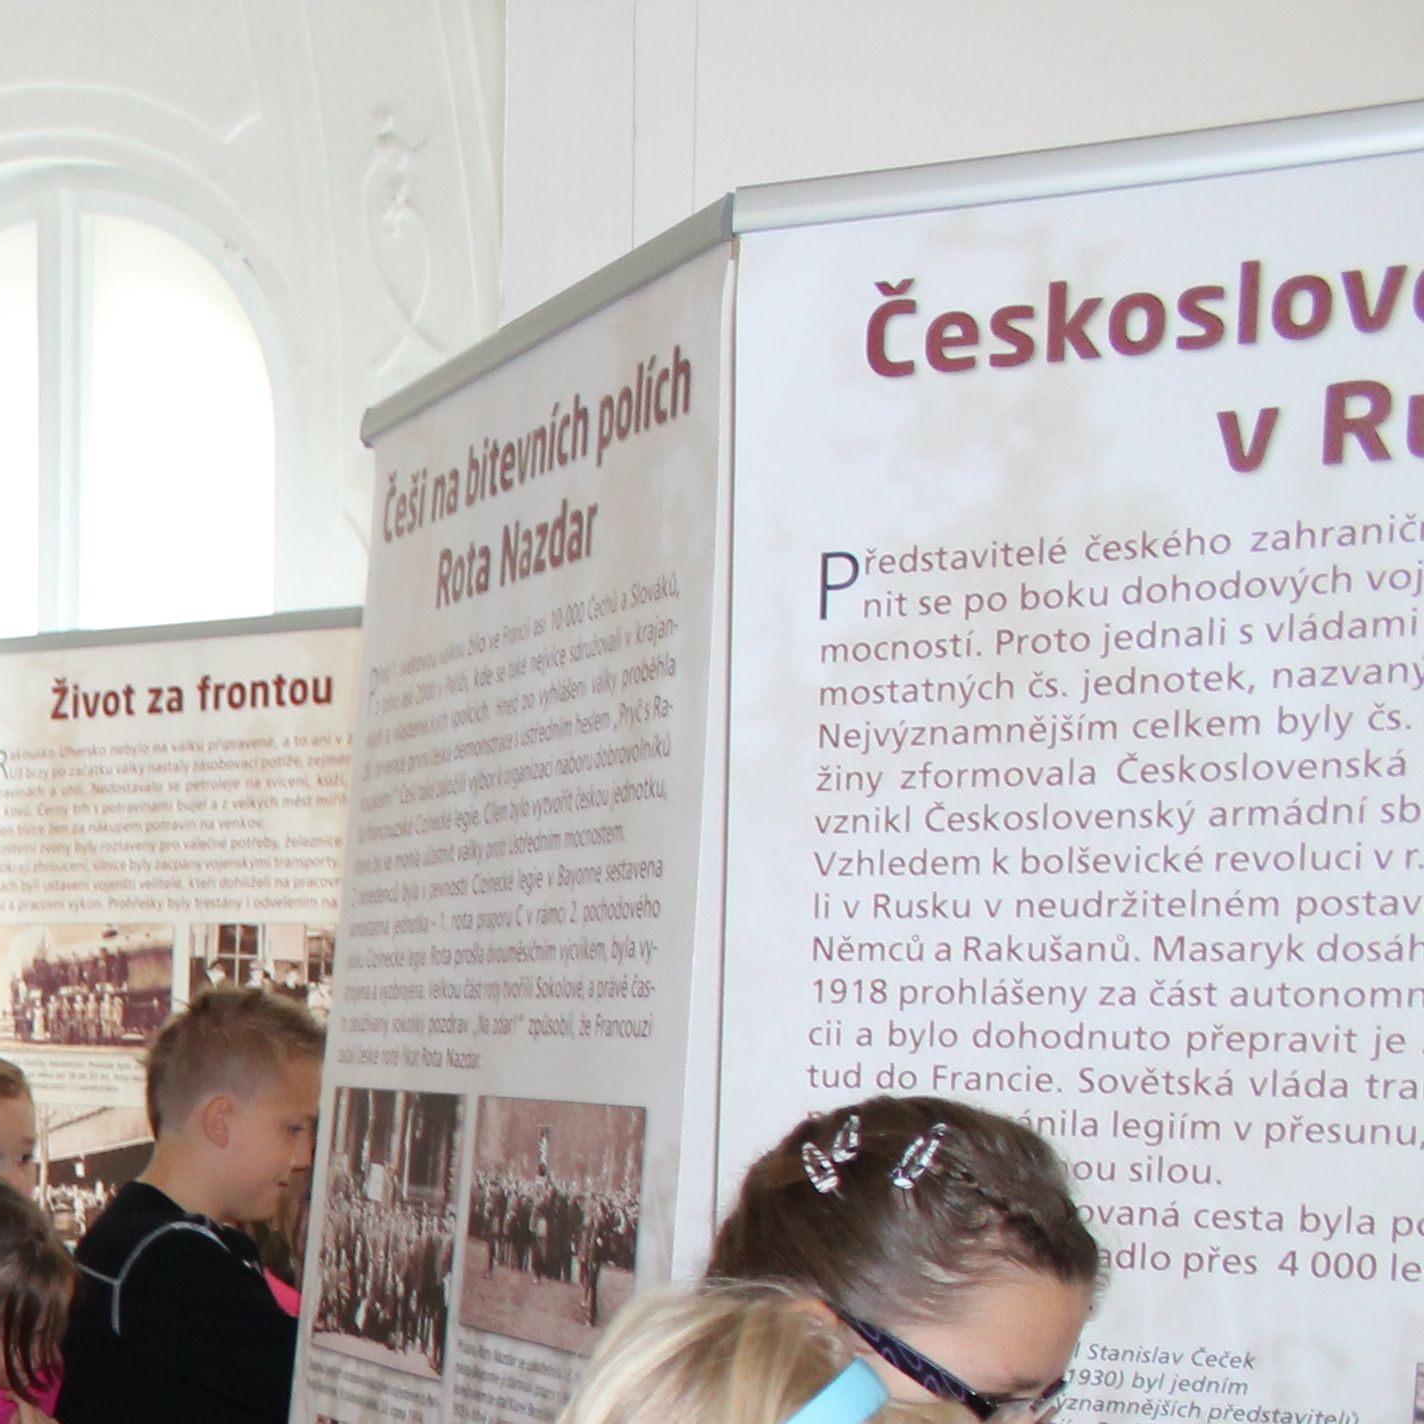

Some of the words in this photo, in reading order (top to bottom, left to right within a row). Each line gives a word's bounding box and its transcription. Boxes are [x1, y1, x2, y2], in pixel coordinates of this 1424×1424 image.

[382, 469, 428, 543] Češi
[431, 462, 458, 524] na
[465, 392, 589, 508] bitevních
[596, 345, 692, 466] polích
[1217, 405, 1280, 474] v
[436, 539, 491, 609] Rota
[500, 499, 599, 587] Nazdar
[1084, 528, 1232, 562] českého
[1250, 513, 1424, 552] zahranič
[1020, 580, 1108, 611] boku
[1122, 564, 1352, 606] dohodových
[820, 630, 982, 664] mocností.
[996, 628, 1091, 656] Proto
[1100, 616, 1226, 659] jednali
[1264, 606, 1418, 643] vládami
[50, 676, 136, 722] Život
[146, 686, 184, 716] za
[196, 674, 334, 712] frontou
[820, 672, 1014, 709] mostatných
[1028, 670, 1068, 700] čs.
[1080, 662, 1255, 704] jednotek,
[818, 713, 1118, 756] Nejvýznamnějším
[1132, 708, 1261, 740] celkem
[1278, 704, 1354, 742] byly
[1368, 702, 1412, 732] čs.
[816, 764, 884, 798] žiny
[900, 756, 1096, 790] zformovala
[1116, 748, 1406, 784] Československá
[814, 805, 910, 834] vznikl
[924, 800, 1196, 836] Československý
[1208, 795, 1368, 828] armádní
[813, 848, 980, 878] Vzhledem
[1020, 844, 1204, 875] bolševické
[1215, 842, 1362, 872] revoluci
[873, 891, 970, 920] Rusku
[1016, 888, 1280, 918] neudržitelném
[1296, 890, 1423, 924] postav
[812, 934, 924, 962] Němců
[963, 934, 1140, 962] Rakušanů.
[1154, 933, 1306, 970] Masaryk
[813, 978, 888, 1004] 1918
[899, 977, 1088, 1014] prohlášeny
[1149, 978, 1218, 1007] část
[888, 1020, 958, 1054] bylo
[972, 1020, 1170, 1052] dohodnuto
[1186, 1024, 1358, 1060] přepravit
[932, 1064, 1062, 1094] Francie.
[1078, 1066, 1234, 1096] Sovětská
[1248, 1068, 1348, 1099] vláda
[1112, 1110, 1220, 1147] legiím
[1128, 1154, 1222, 1186] silou.
[1194, 1206, 1284, 1232] cesta
[1300, 1204, 1376, 1242] byla
[1183, 1245, 1258, 1280] přes
[1310, 1251, 1378, 1280] 000
[1086, 1343, 1184, 1366] Stanislav
[1191, 1346, 1256, 1370] Čeček
[1131, 1370, 1166, 1394] byl
[1167, 1374, 1248, 1396] jedním
